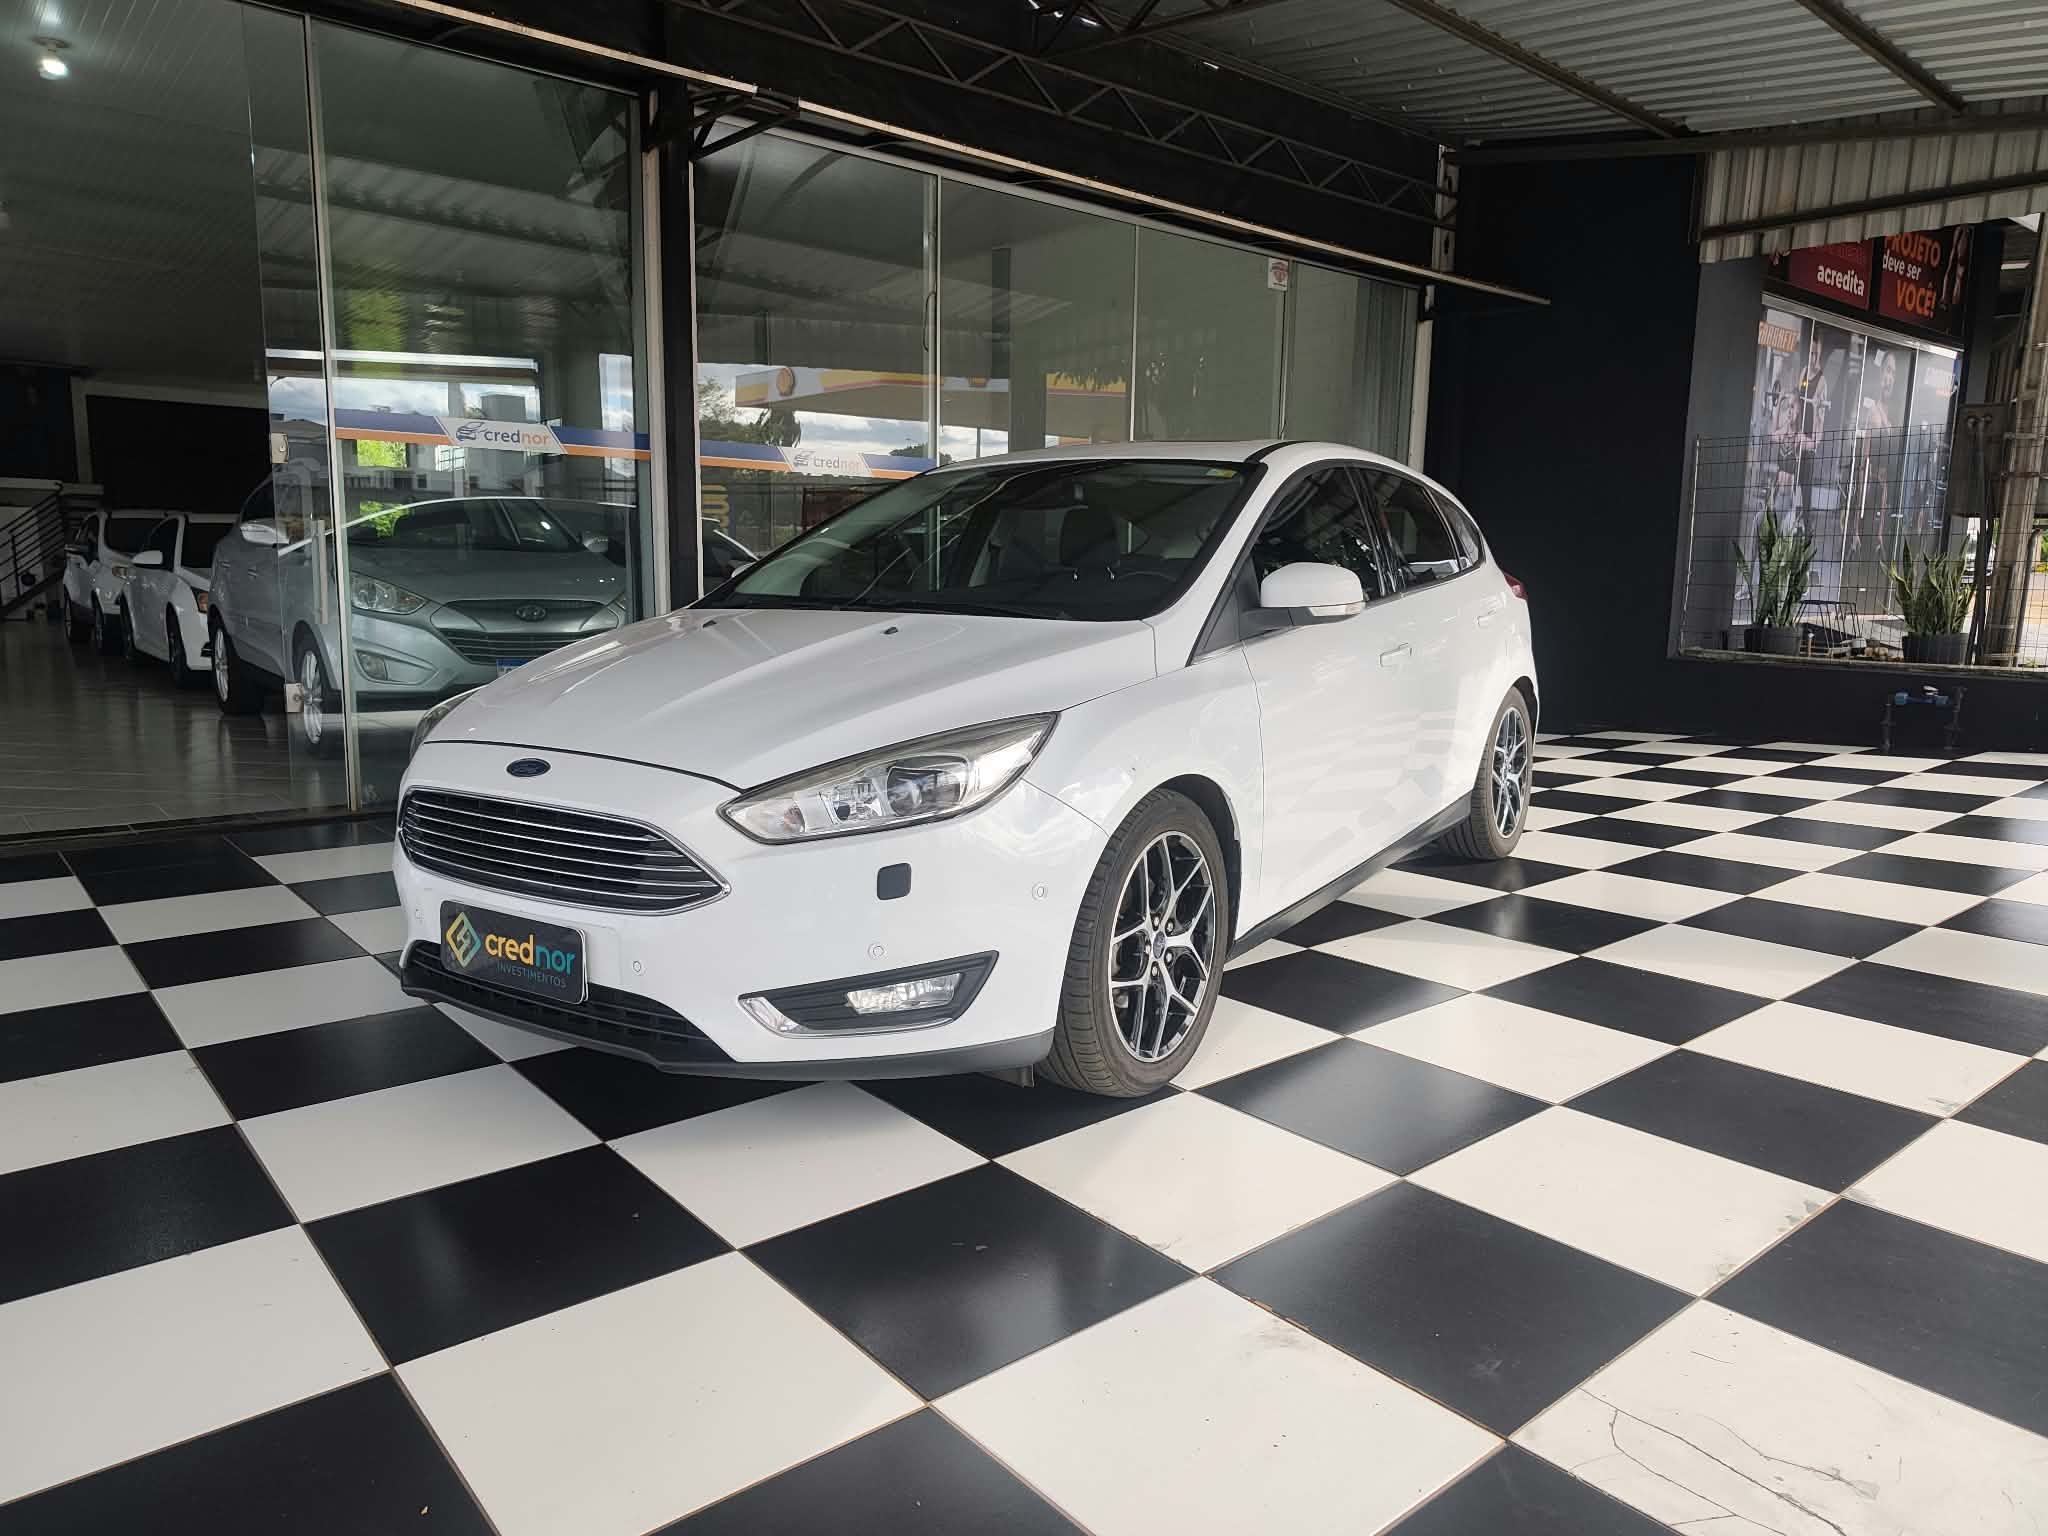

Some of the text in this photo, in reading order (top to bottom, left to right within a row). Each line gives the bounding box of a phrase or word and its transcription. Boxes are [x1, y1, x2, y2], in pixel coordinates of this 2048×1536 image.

[1817, 264, 1865, 297] acredita
[1882, 250, 1905, 276] deve
[1906, 263, 1922, 281] ser
[1896, 280, 1937, 319] VOCÊ!
[484, 429, 552, 445] crednor
[485, 934, 576, 975] crednor
[497, 963, 567, 988] INVESTIMENTOS
